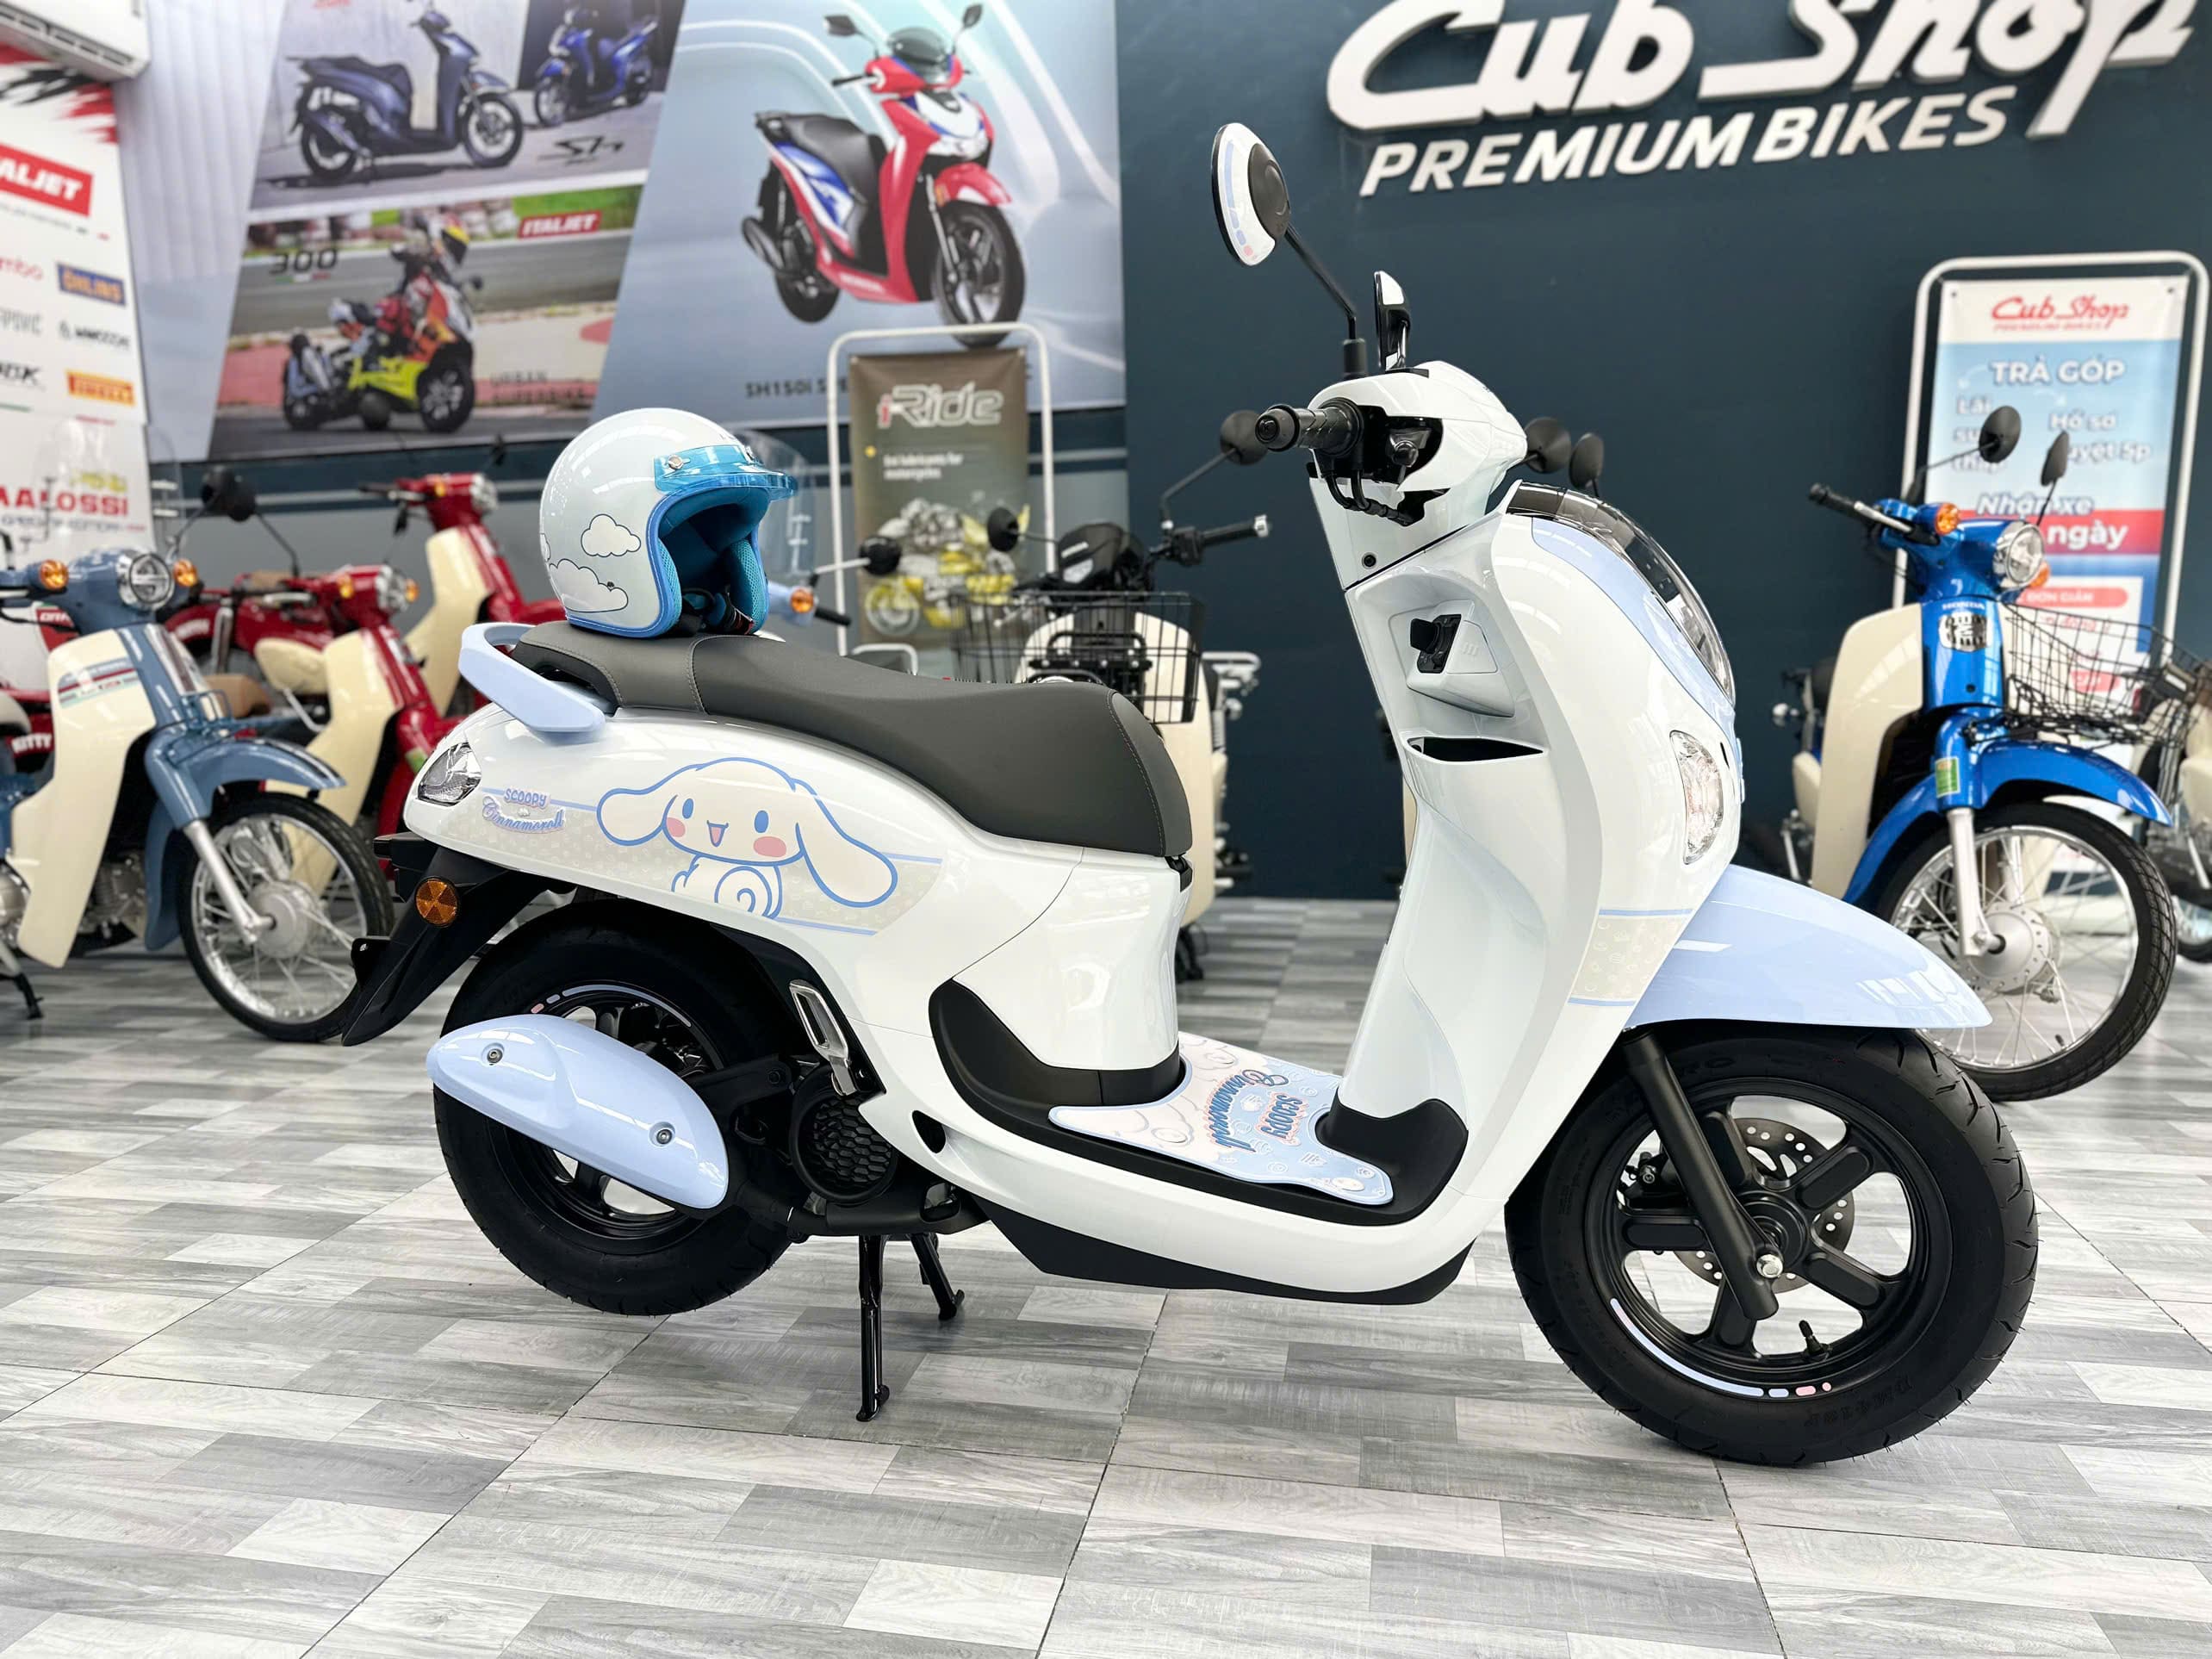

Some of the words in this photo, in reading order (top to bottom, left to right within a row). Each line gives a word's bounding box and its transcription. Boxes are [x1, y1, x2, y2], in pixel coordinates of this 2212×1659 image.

[1327, 0, 1693, 131] Cub
[1359, 114, 1755, 196] PREMIUM
[1752, 84, 2017, 165] BIKES
[269, 247, 338, 276] 300
[1991, 295, 2055, 320] Cub
[2055, 294, 2130, 331] Shop
[1991, 354, 2052, 385] TRẢ
[2057, 354, 2127, 383] GÓP
[2047, 519, 2129, 550] ngày
[482, 795, 565, 831] Cinnamoroll
[1208, 1069, 1289, 1153] Cinnamoroll
